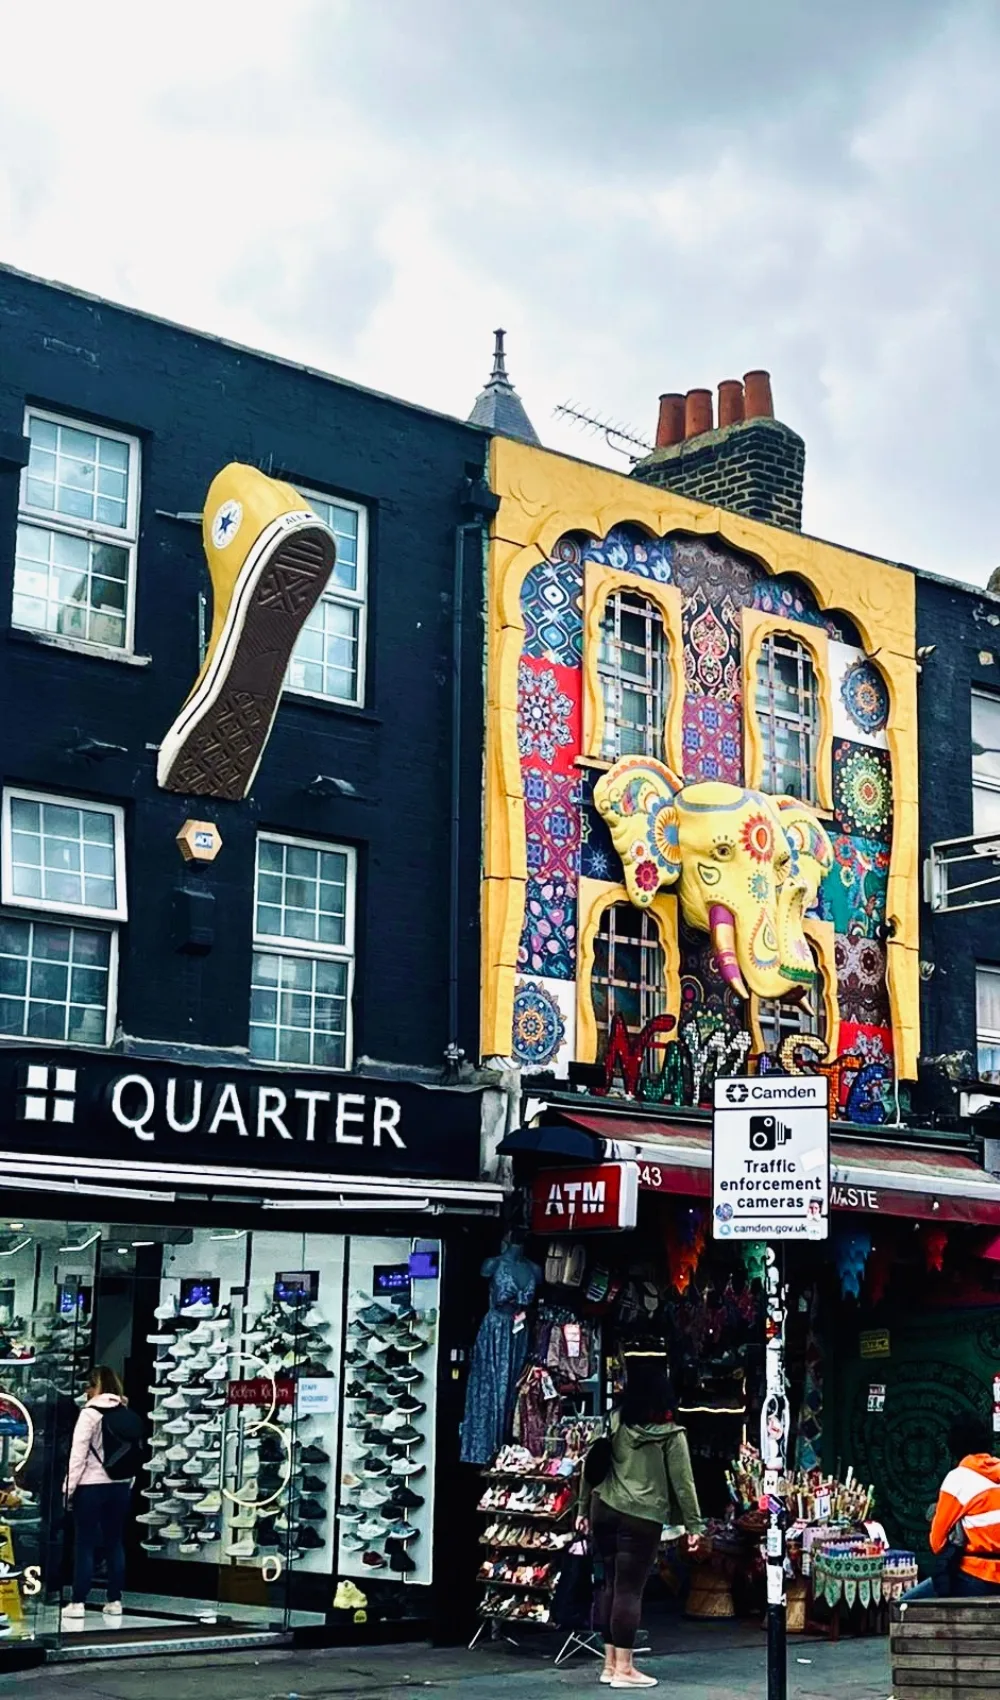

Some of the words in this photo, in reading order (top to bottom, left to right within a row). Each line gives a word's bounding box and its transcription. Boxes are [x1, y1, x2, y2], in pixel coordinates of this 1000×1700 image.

[751, 1086, 817, 1100] Camden
[111, 1074, 407, 1149] QUARTER
[744, 1159, 796, 1173] Traffic
[720, 1176, 822, 1191] enforcement
[545, 1181, 607, 1215] ATM
[737, 1195, 804, 1209] cameras
[733, 1222, 808, 1234] camden.gov.uk
